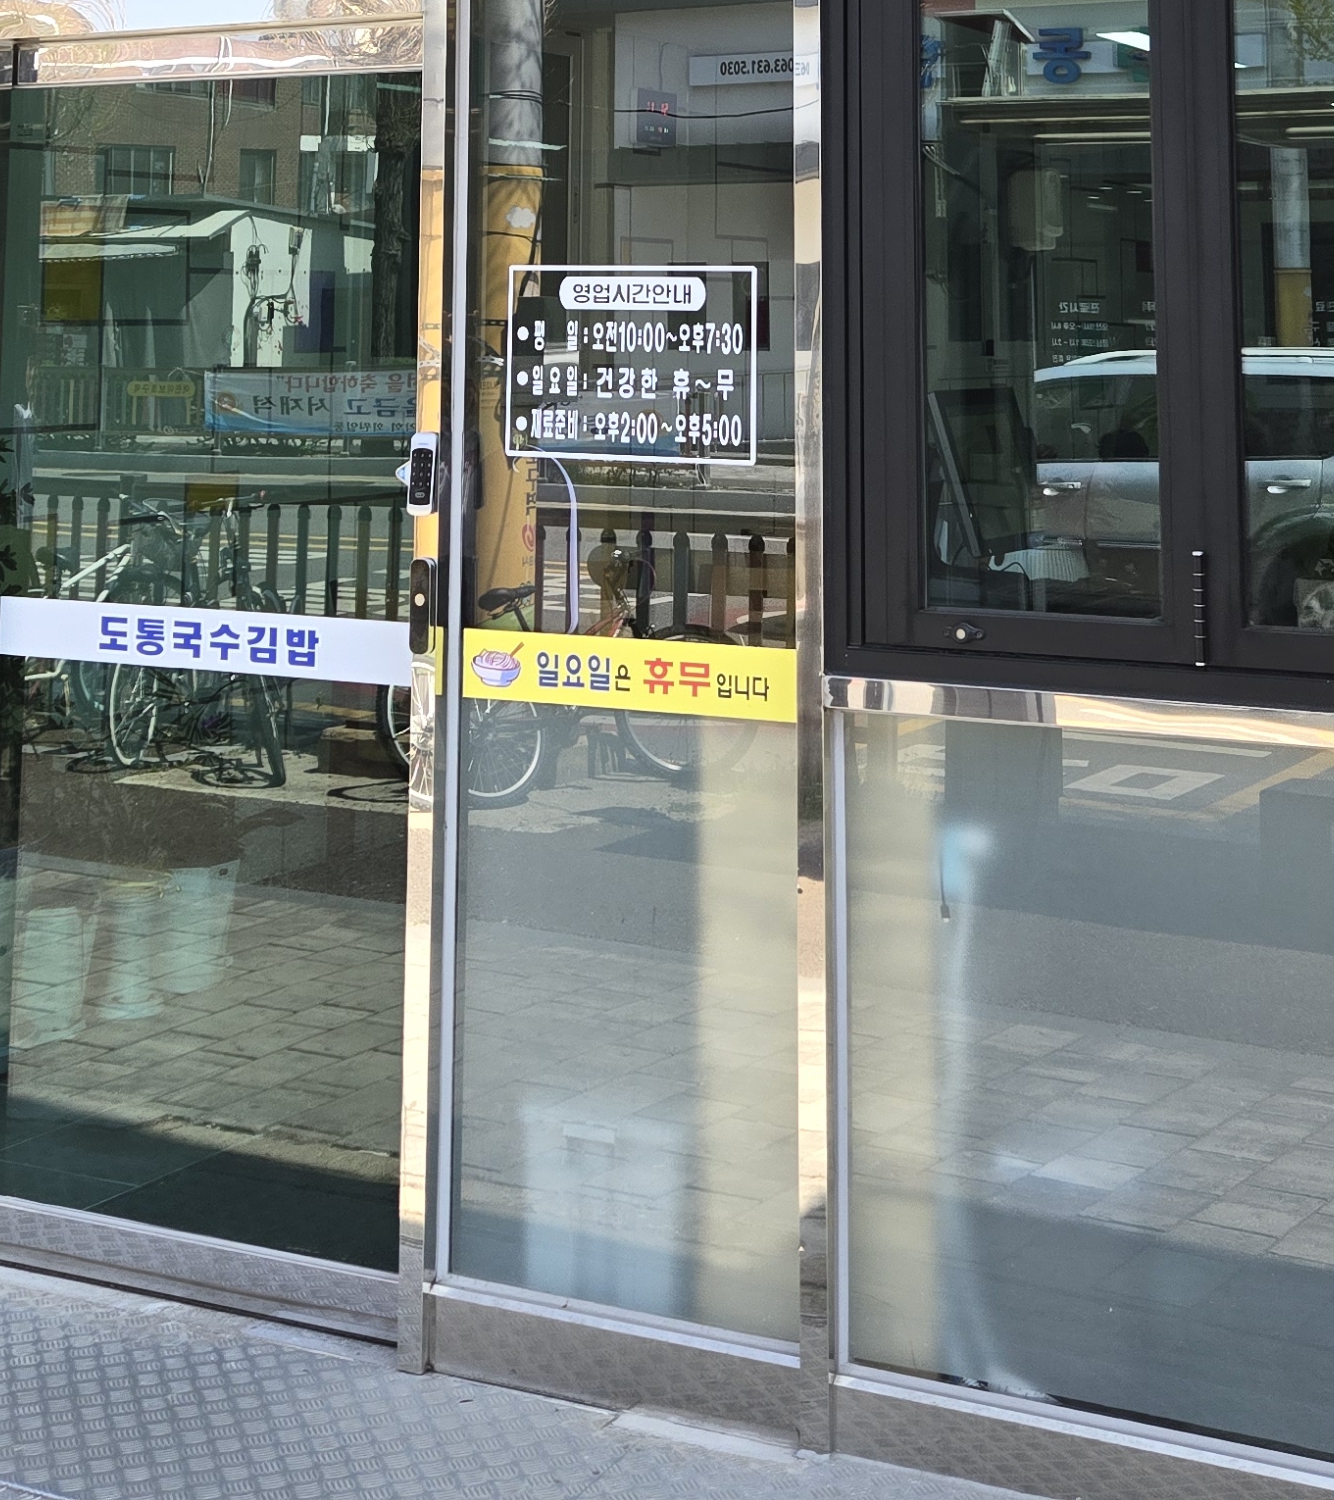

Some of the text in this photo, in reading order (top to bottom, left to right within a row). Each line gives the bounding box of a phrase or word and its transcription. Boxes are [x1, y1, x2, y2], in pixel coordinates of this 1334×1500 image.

[571, 281, 693, 306] 영업시간안내
[98, 614, 321, 668] 도통국수김밥
[536, 650, 632, 693] 일요일은
